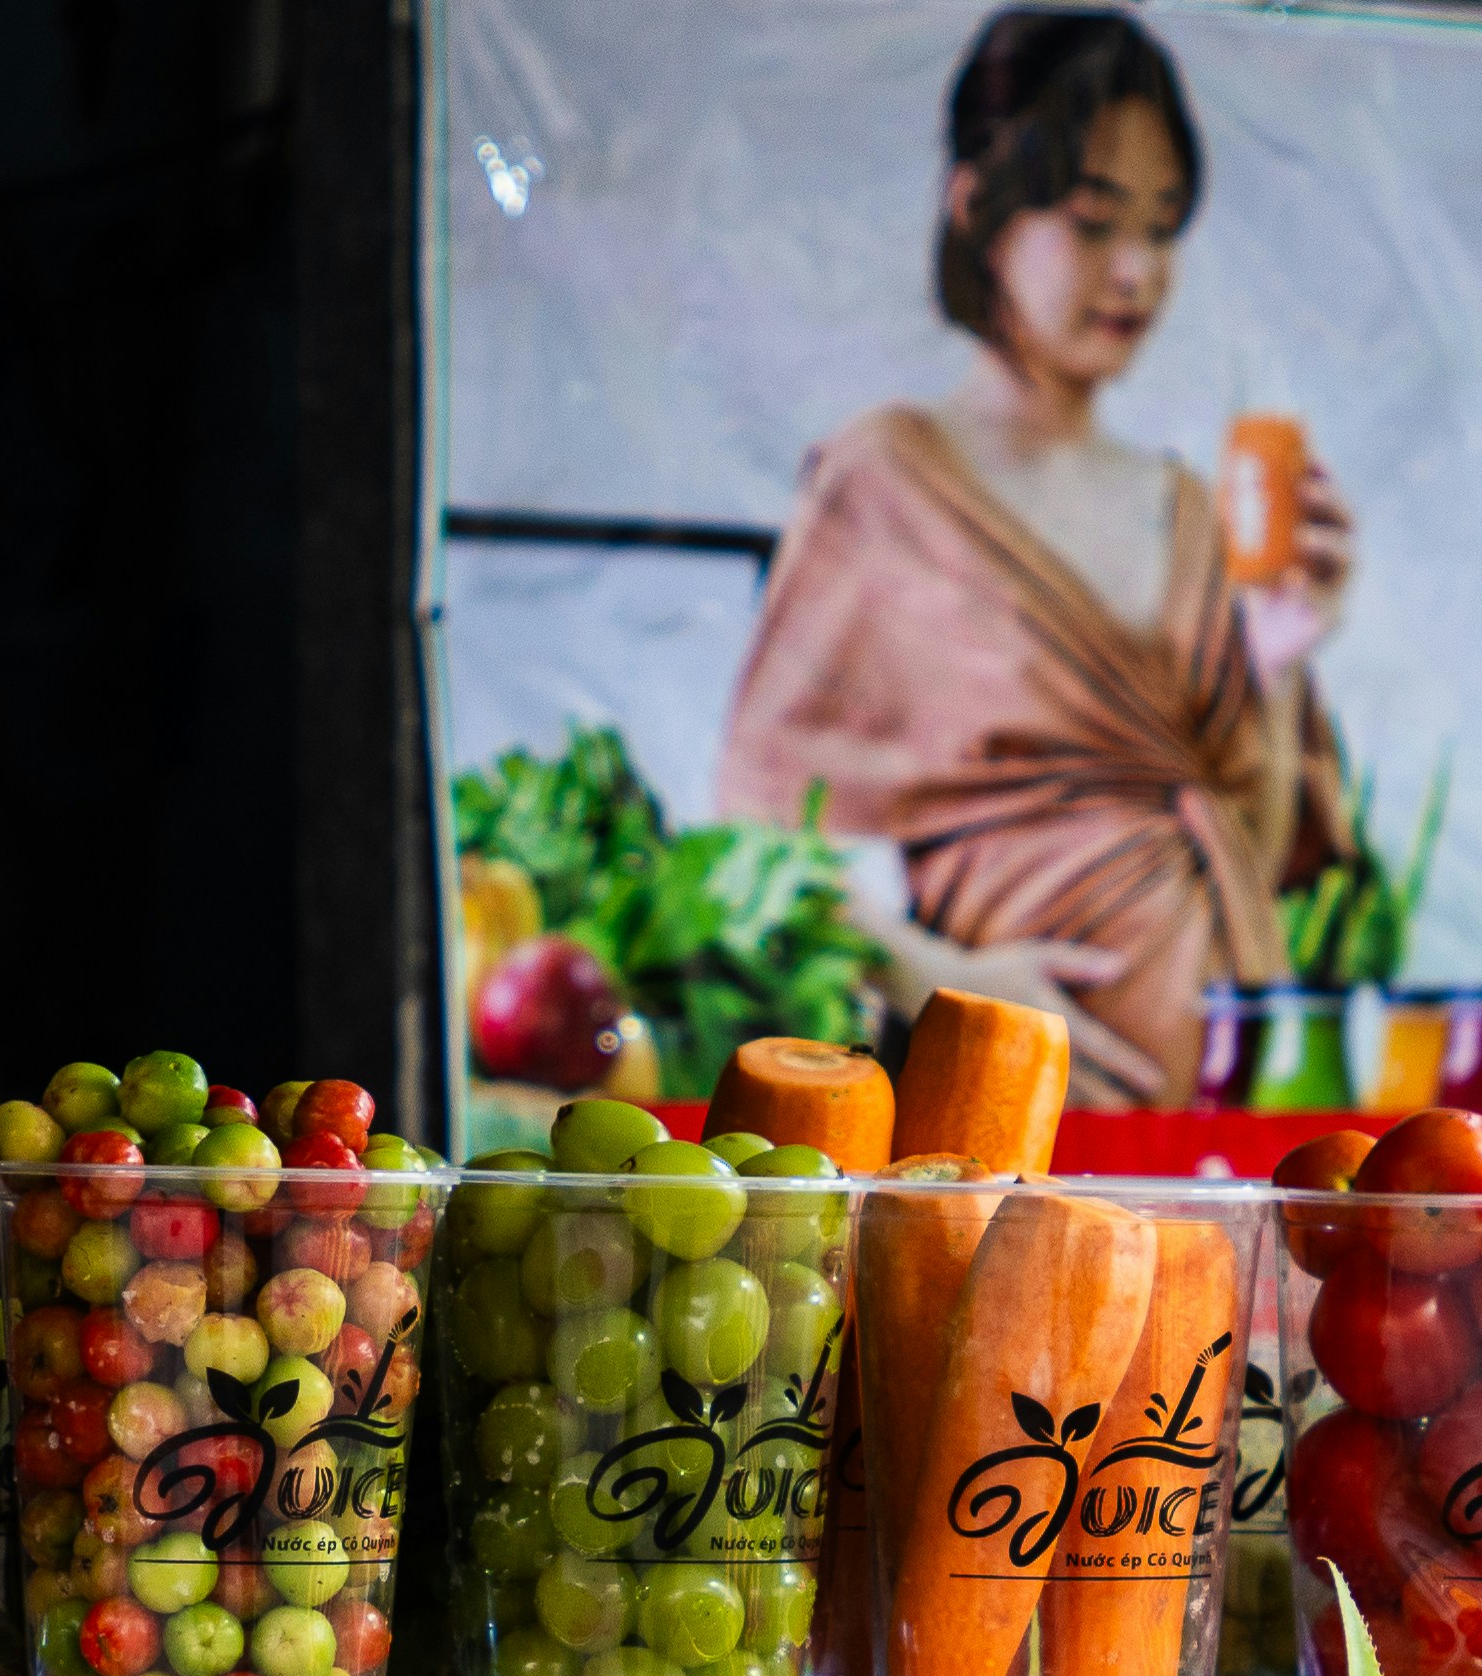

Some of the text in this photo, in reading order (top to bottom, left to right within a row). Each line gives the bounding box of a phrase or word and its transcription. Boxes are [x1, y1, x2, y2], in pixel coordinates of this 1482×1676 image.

[133, 1421, 404, 1551] JUICE
[947, 1444, 1221, 1568] JUICE
[262, 1534, 312, 1552] Nước
[317, 1535, 338, 1555] ép
[342, 1534, 358, 1552] Cô
[760, 1537, 777, 1555] ép
[1066, 1552, 1115, 1568] Nước
[1120, 1553, 1142, 1571] ép
[1148, 1552, 1167, 1567] Cô
